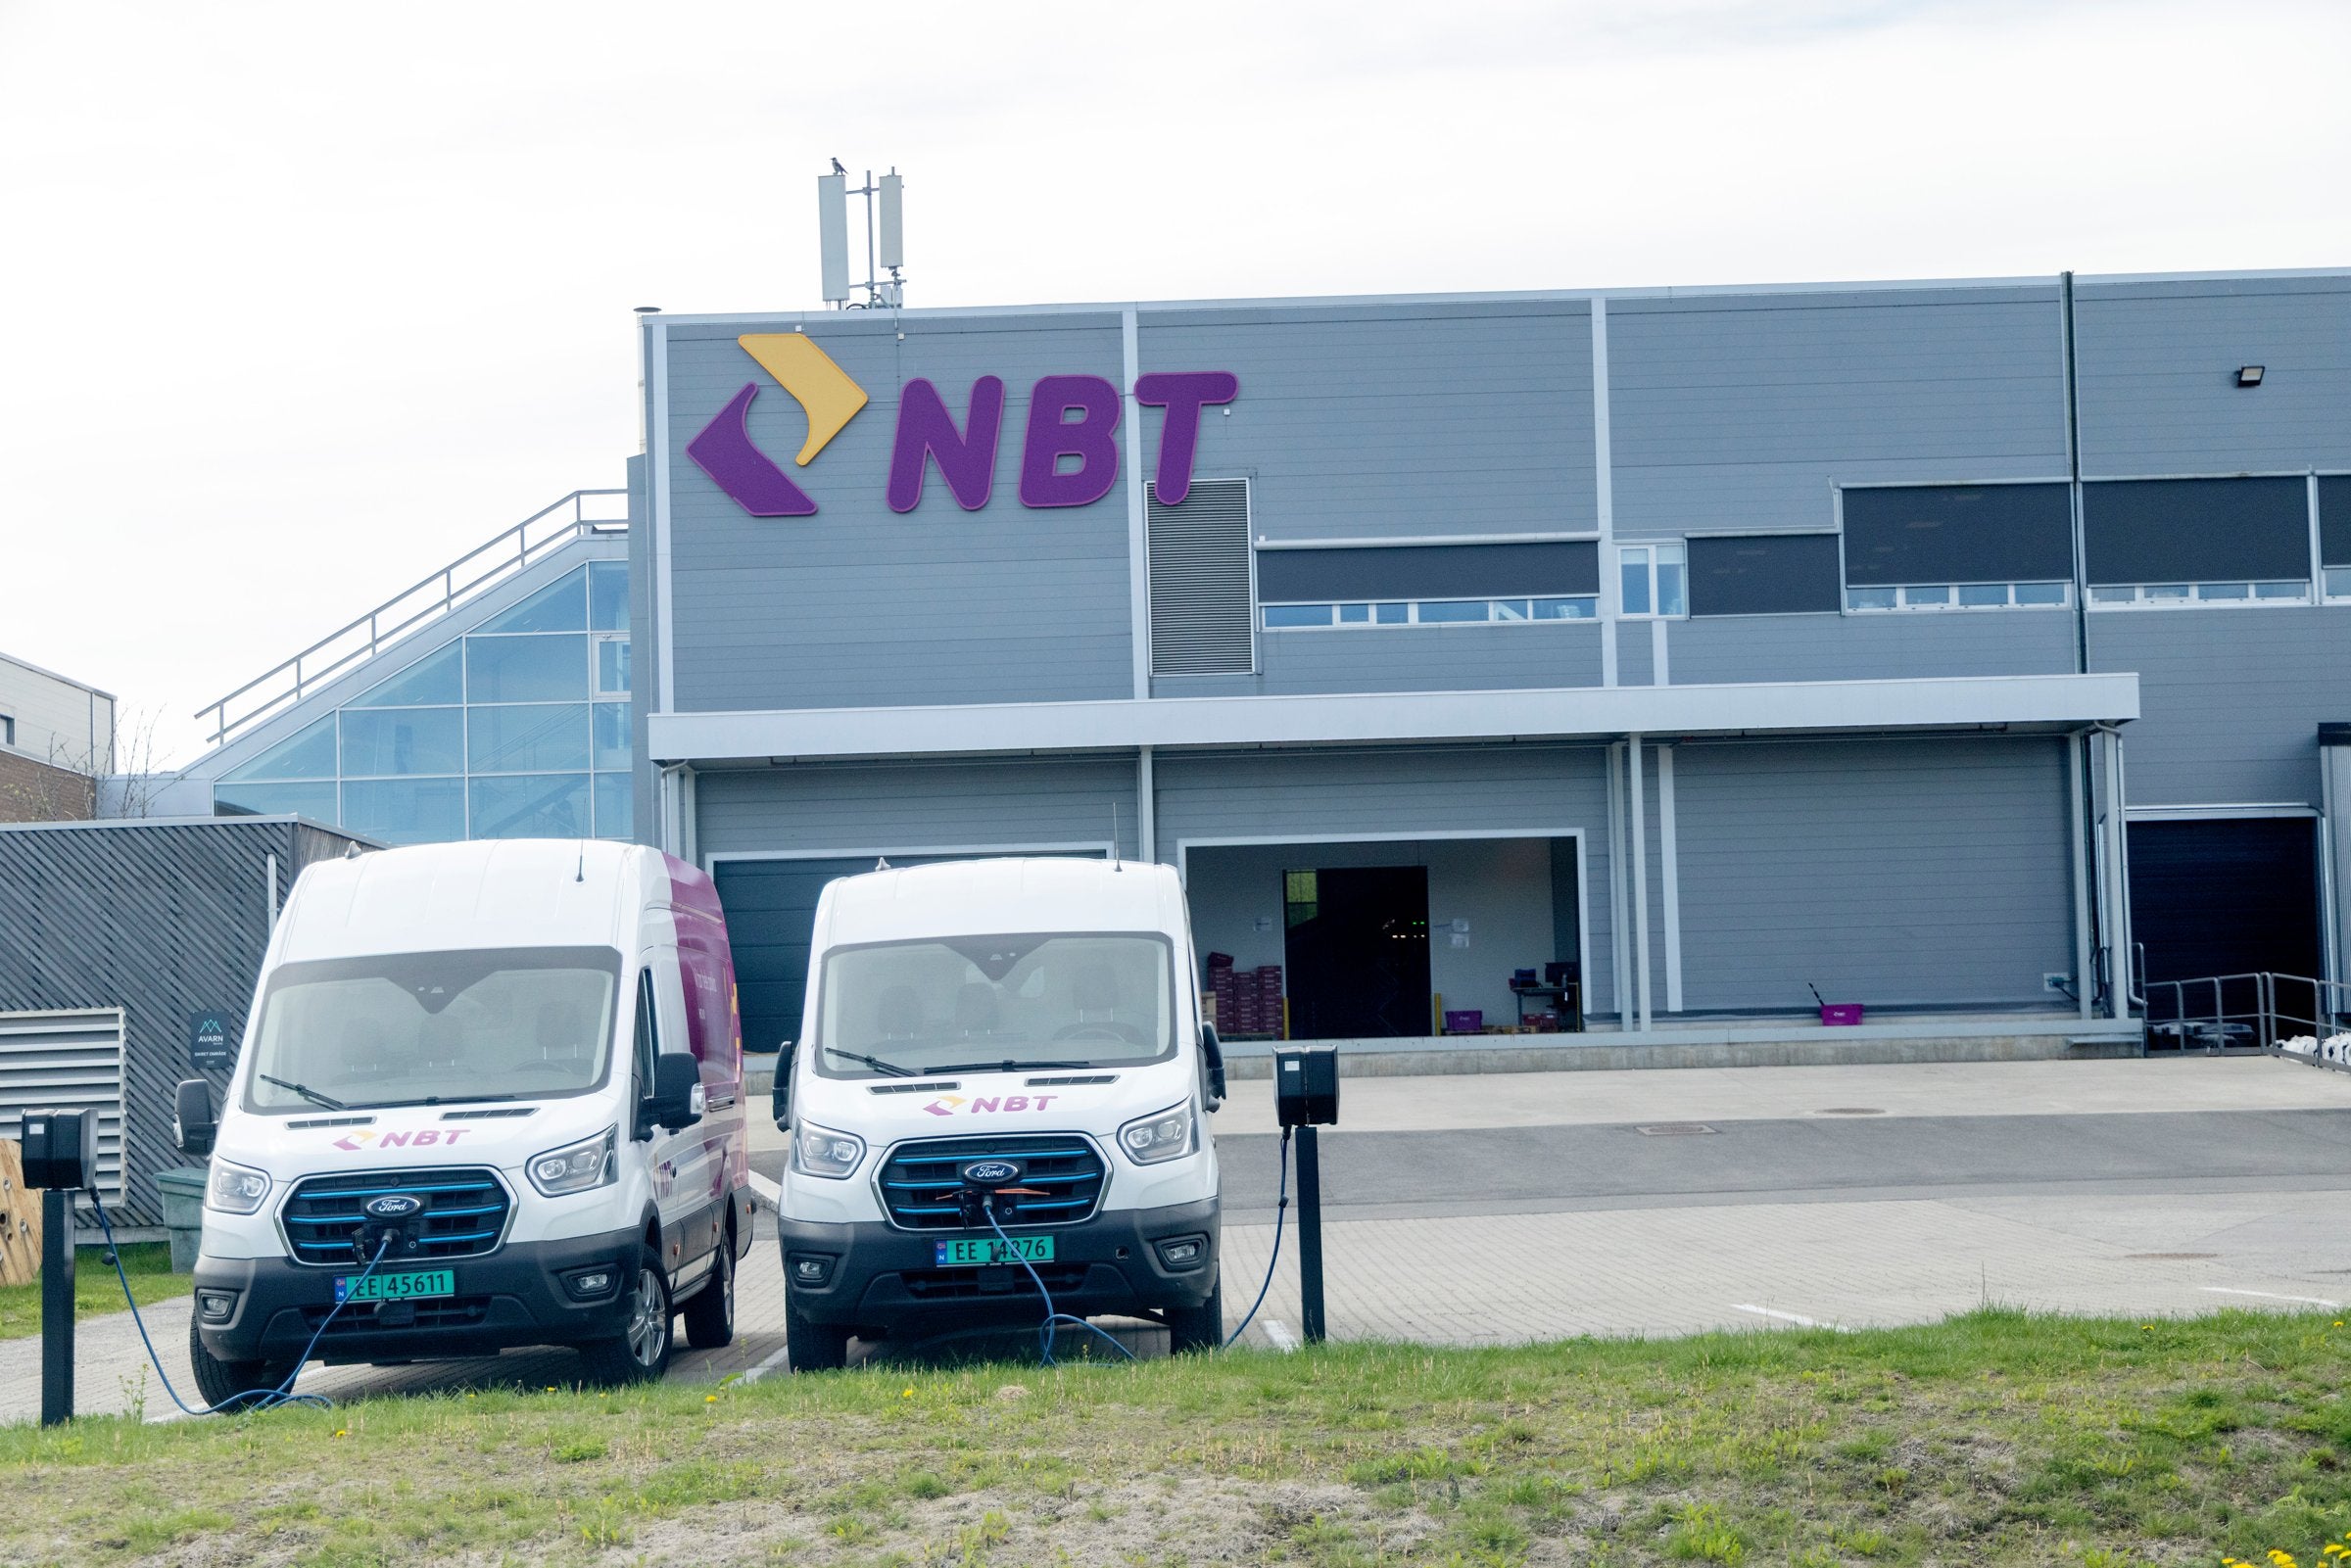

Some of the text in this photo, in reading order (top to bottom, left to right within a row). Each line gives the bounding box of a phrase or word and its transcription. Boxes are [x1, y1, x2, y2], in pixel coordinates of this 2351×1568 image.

[886, 370, 1239, 514] NBT
[970, 1095, 1058, 1114] NBT
[379, 1129, 470, 1149] NBT
[977, 1164, 1006, 1177] Ford
[378, 1199, 408, 1212] Ford
[955, 1242, 977, 1260] EE
[387, 1273, 446, 1295] 45611
